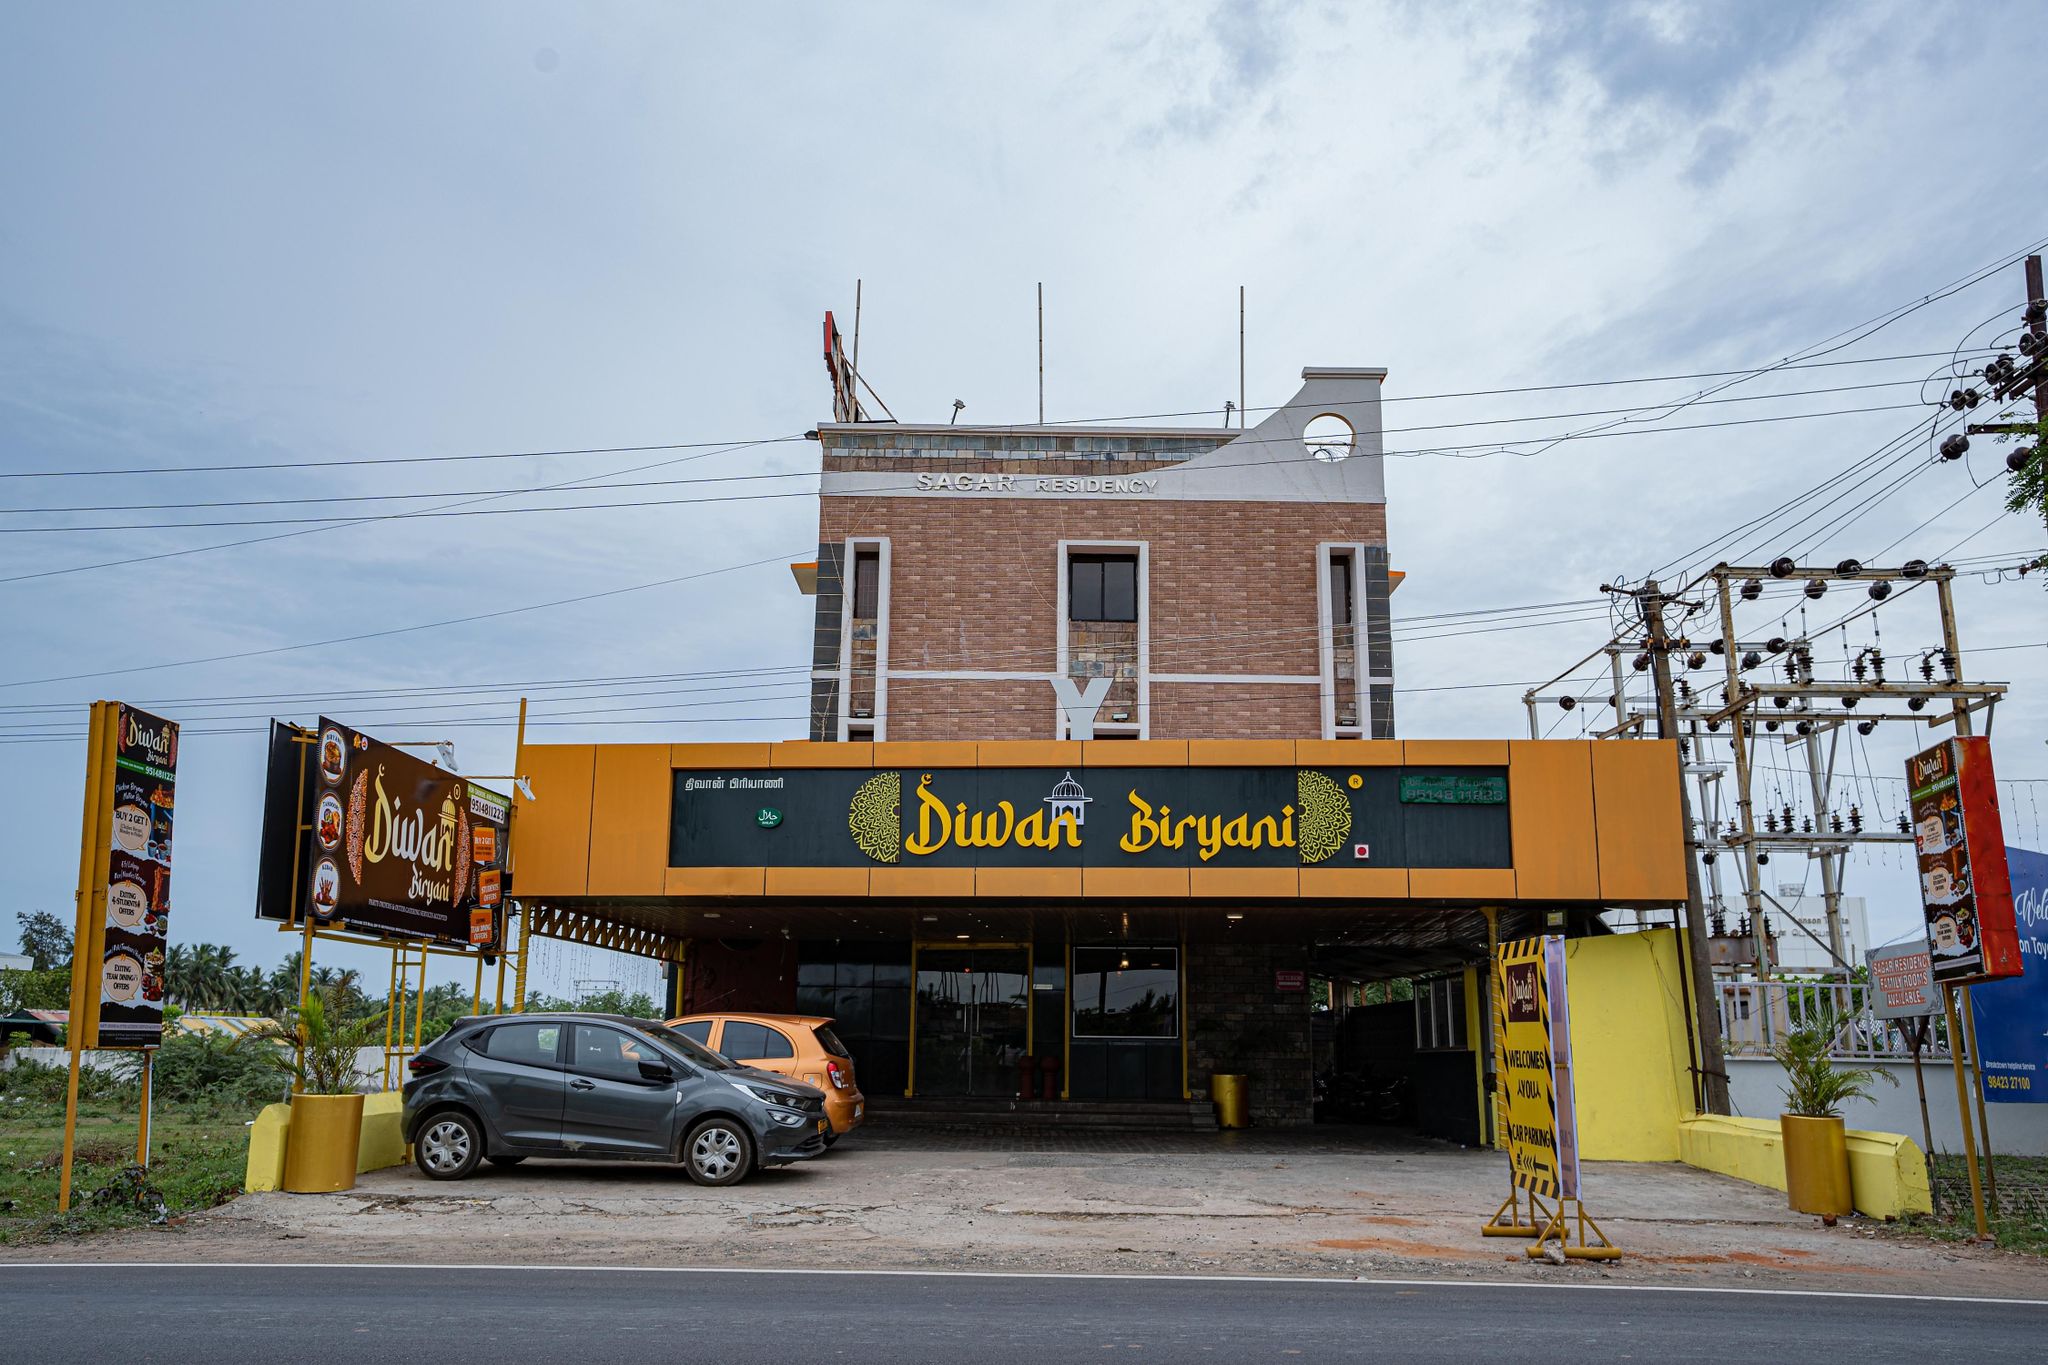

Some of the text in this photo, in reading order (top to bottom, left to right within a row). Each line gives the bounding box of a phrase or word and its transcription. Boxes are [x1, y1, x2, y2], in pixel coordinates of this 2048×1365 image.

[917, 472, 1158, 494] SAGAR RESIDENCY
[126, 713, 169, 754] Diwan
[1918, 757, 1943, 781] Diwan
[685, 776, 784, 791] திவான் பிரியாணி
[115, 810, 129, 820] BUY
[128, 812, 134, 823] 2
[365, 768, 452, 872] Diwan
[471, 798, 504, 821] 9514811223
[758, 809, 778, 821] حلال
[905, 776, 1296, 861] Diwan Biryani
[408, 862, 450, 906] Biryani
[1873, 960, 1894, 975] SAGAR
[1894, 953, 1931, 972] RESIDENCY
[1880, 971, 1928, 989] FAMILY ROOMS
[1508, 1049, 1545, 1070] WELCOMES
[1988, 1075, 2031, 1090] 98423 27100
[1512, 1124, 1551, 1148] CAR PARKING
